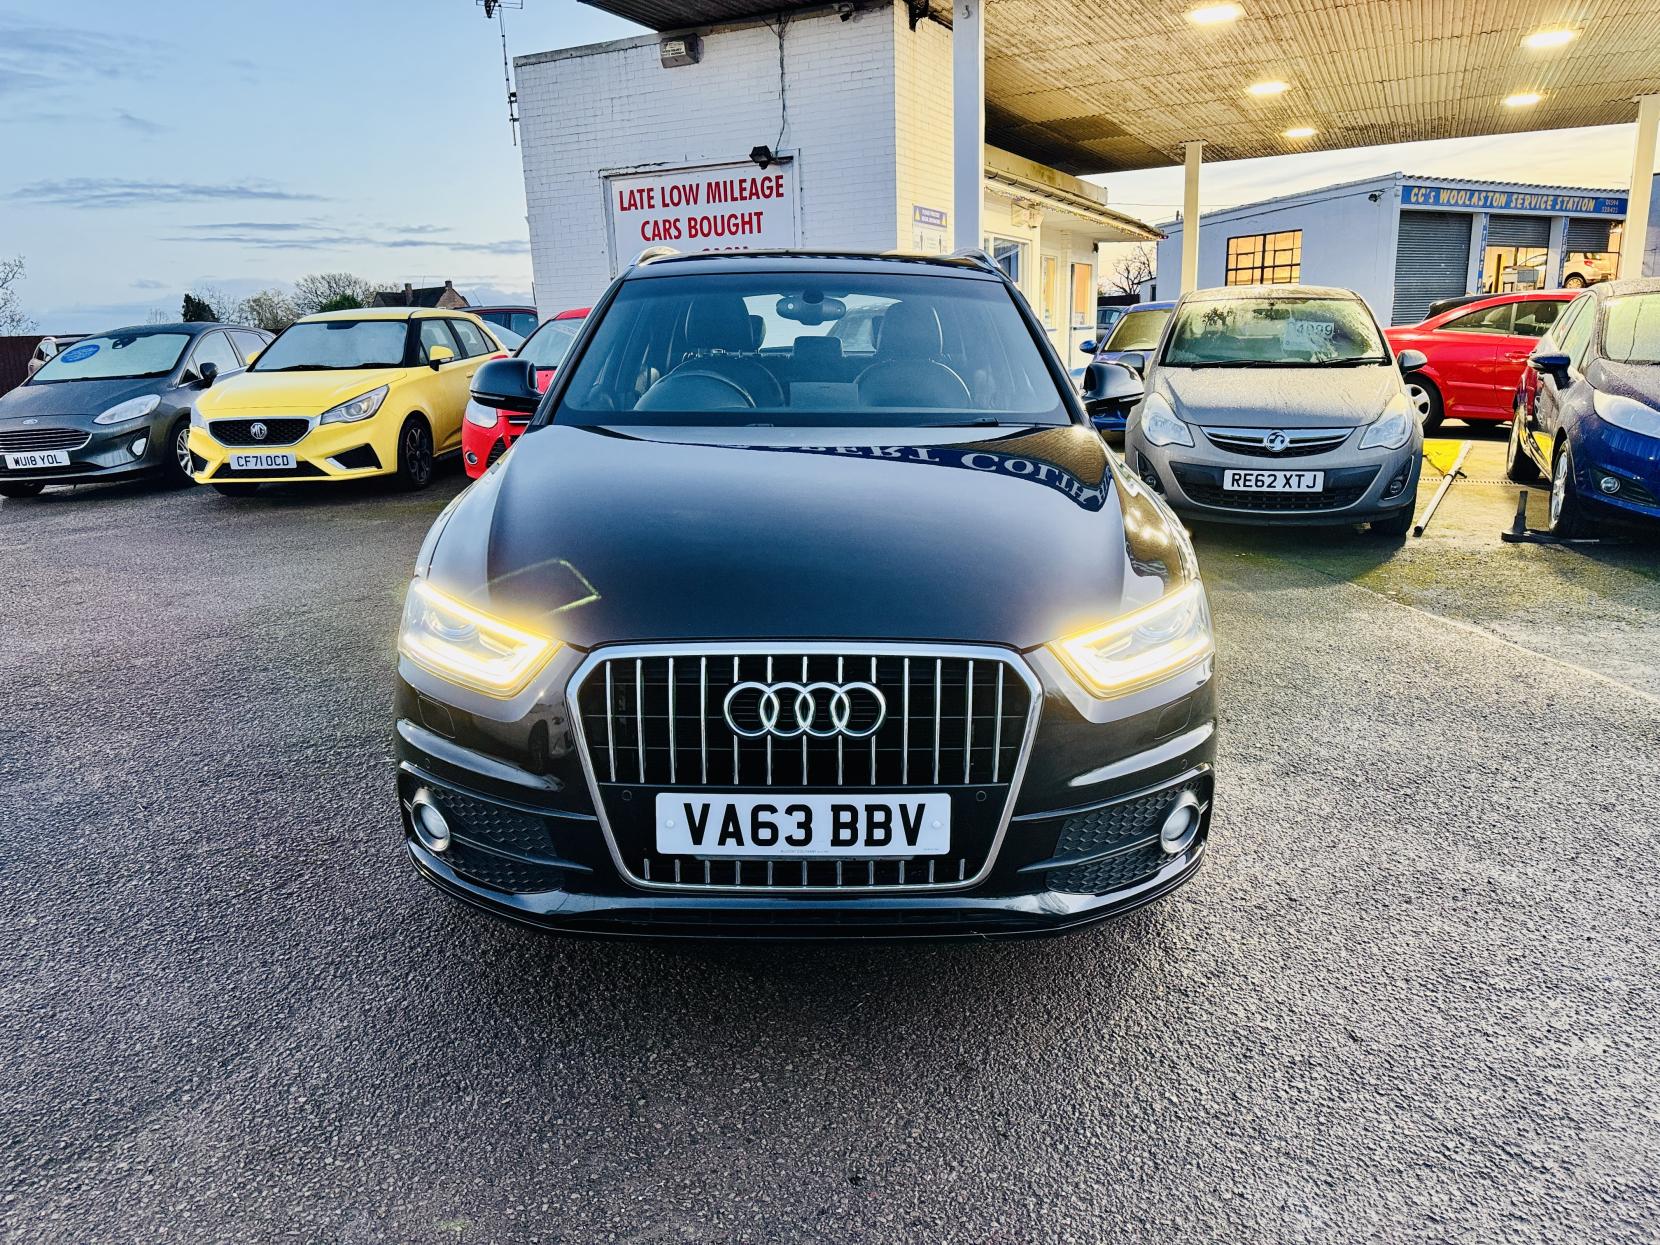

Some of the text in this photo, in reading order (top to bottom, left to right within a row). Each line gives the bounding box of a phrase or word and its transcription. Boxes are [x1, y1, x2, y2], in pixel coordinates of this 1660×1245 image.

[618, 174, 785, 212] LATE LOW MILEAGE
[1440, 189, 1508, 208] WOOLASTON
[1510, 193, 1553, 210] SERVICE
[1555, 195, 1595, 212] STATION
[640, 211, 764, 242] CARS BOUGHT
[13, 453, 63, 467] WU18 YOL
[236, 454, 290, 467] CF71 OCD
[1231, 472, 1317, 489] RE62 XTJ
[683, 802, 927, 848] VA63 BBV
